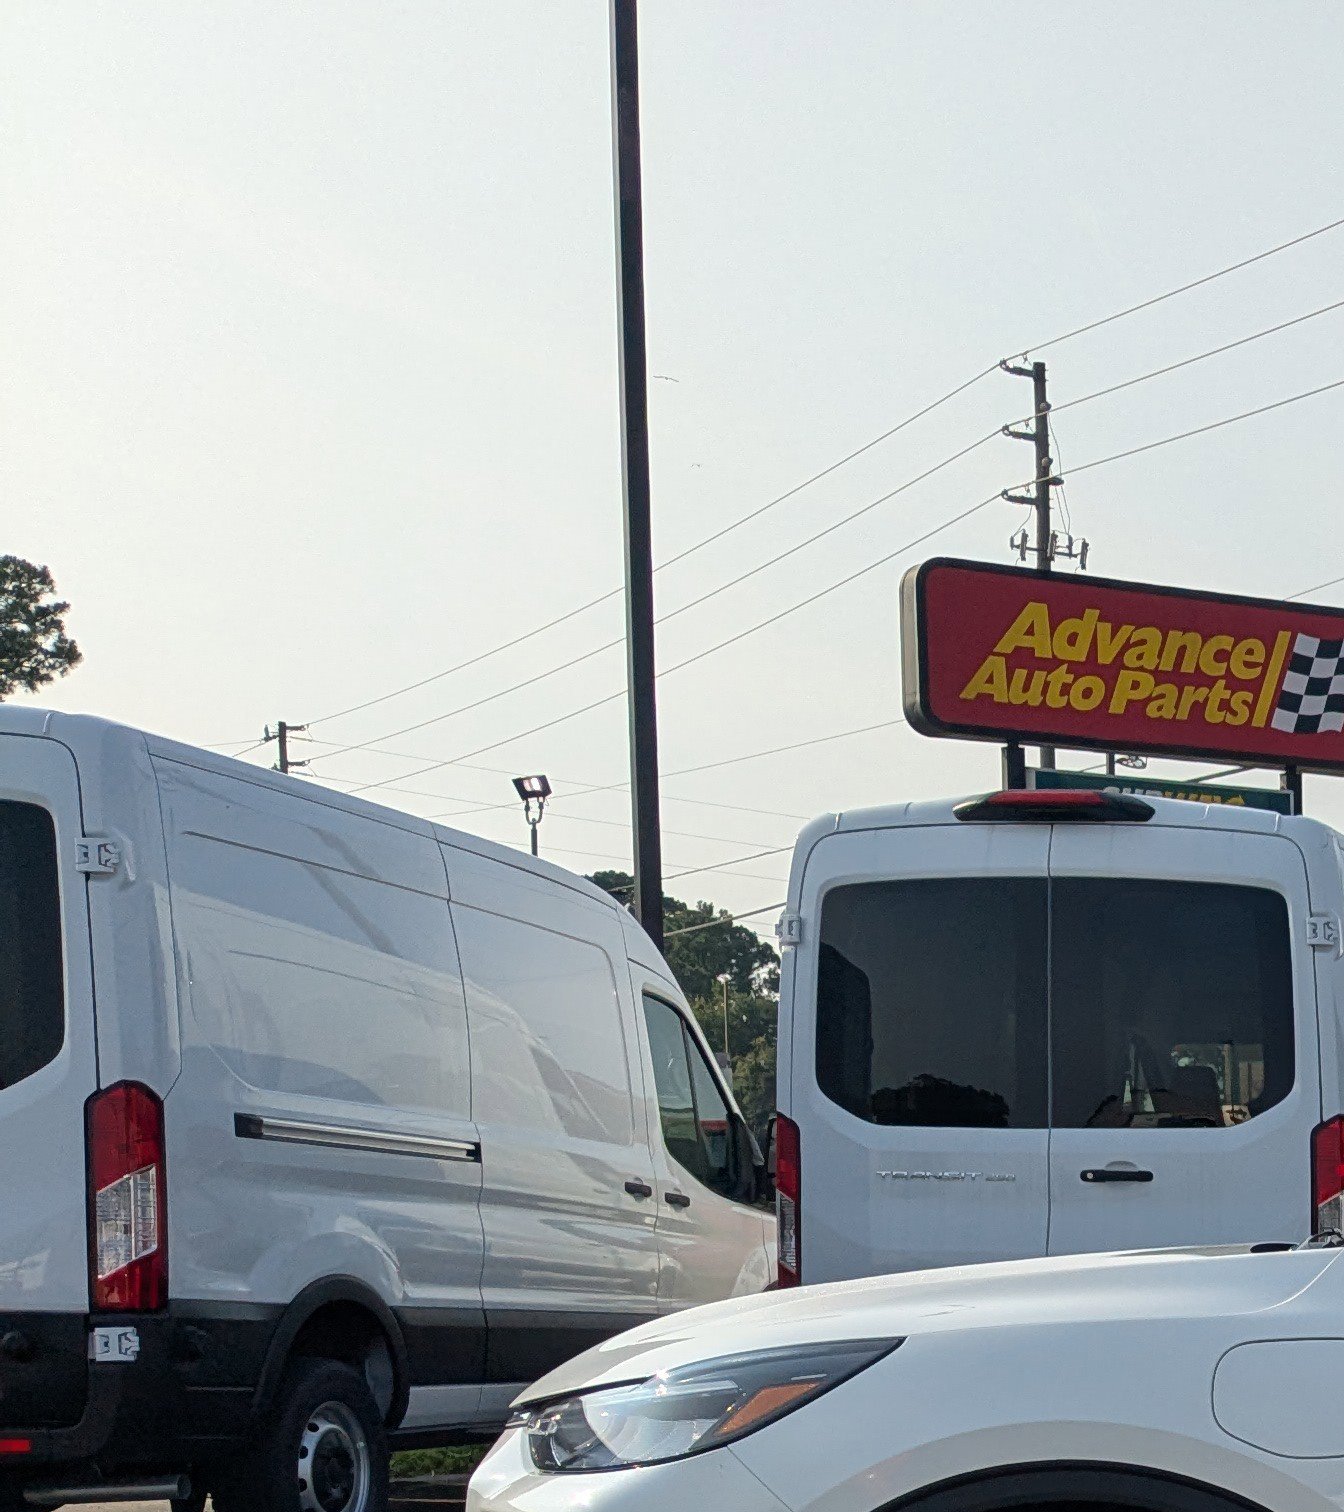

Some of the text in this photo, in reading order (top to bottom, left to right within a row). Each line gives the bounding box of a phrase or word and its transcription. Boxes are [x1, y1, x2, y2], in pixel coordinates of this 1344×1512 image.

[992, 602, 1266, 679] Advance
[959, 655, 1253, 726] Auto Parts
